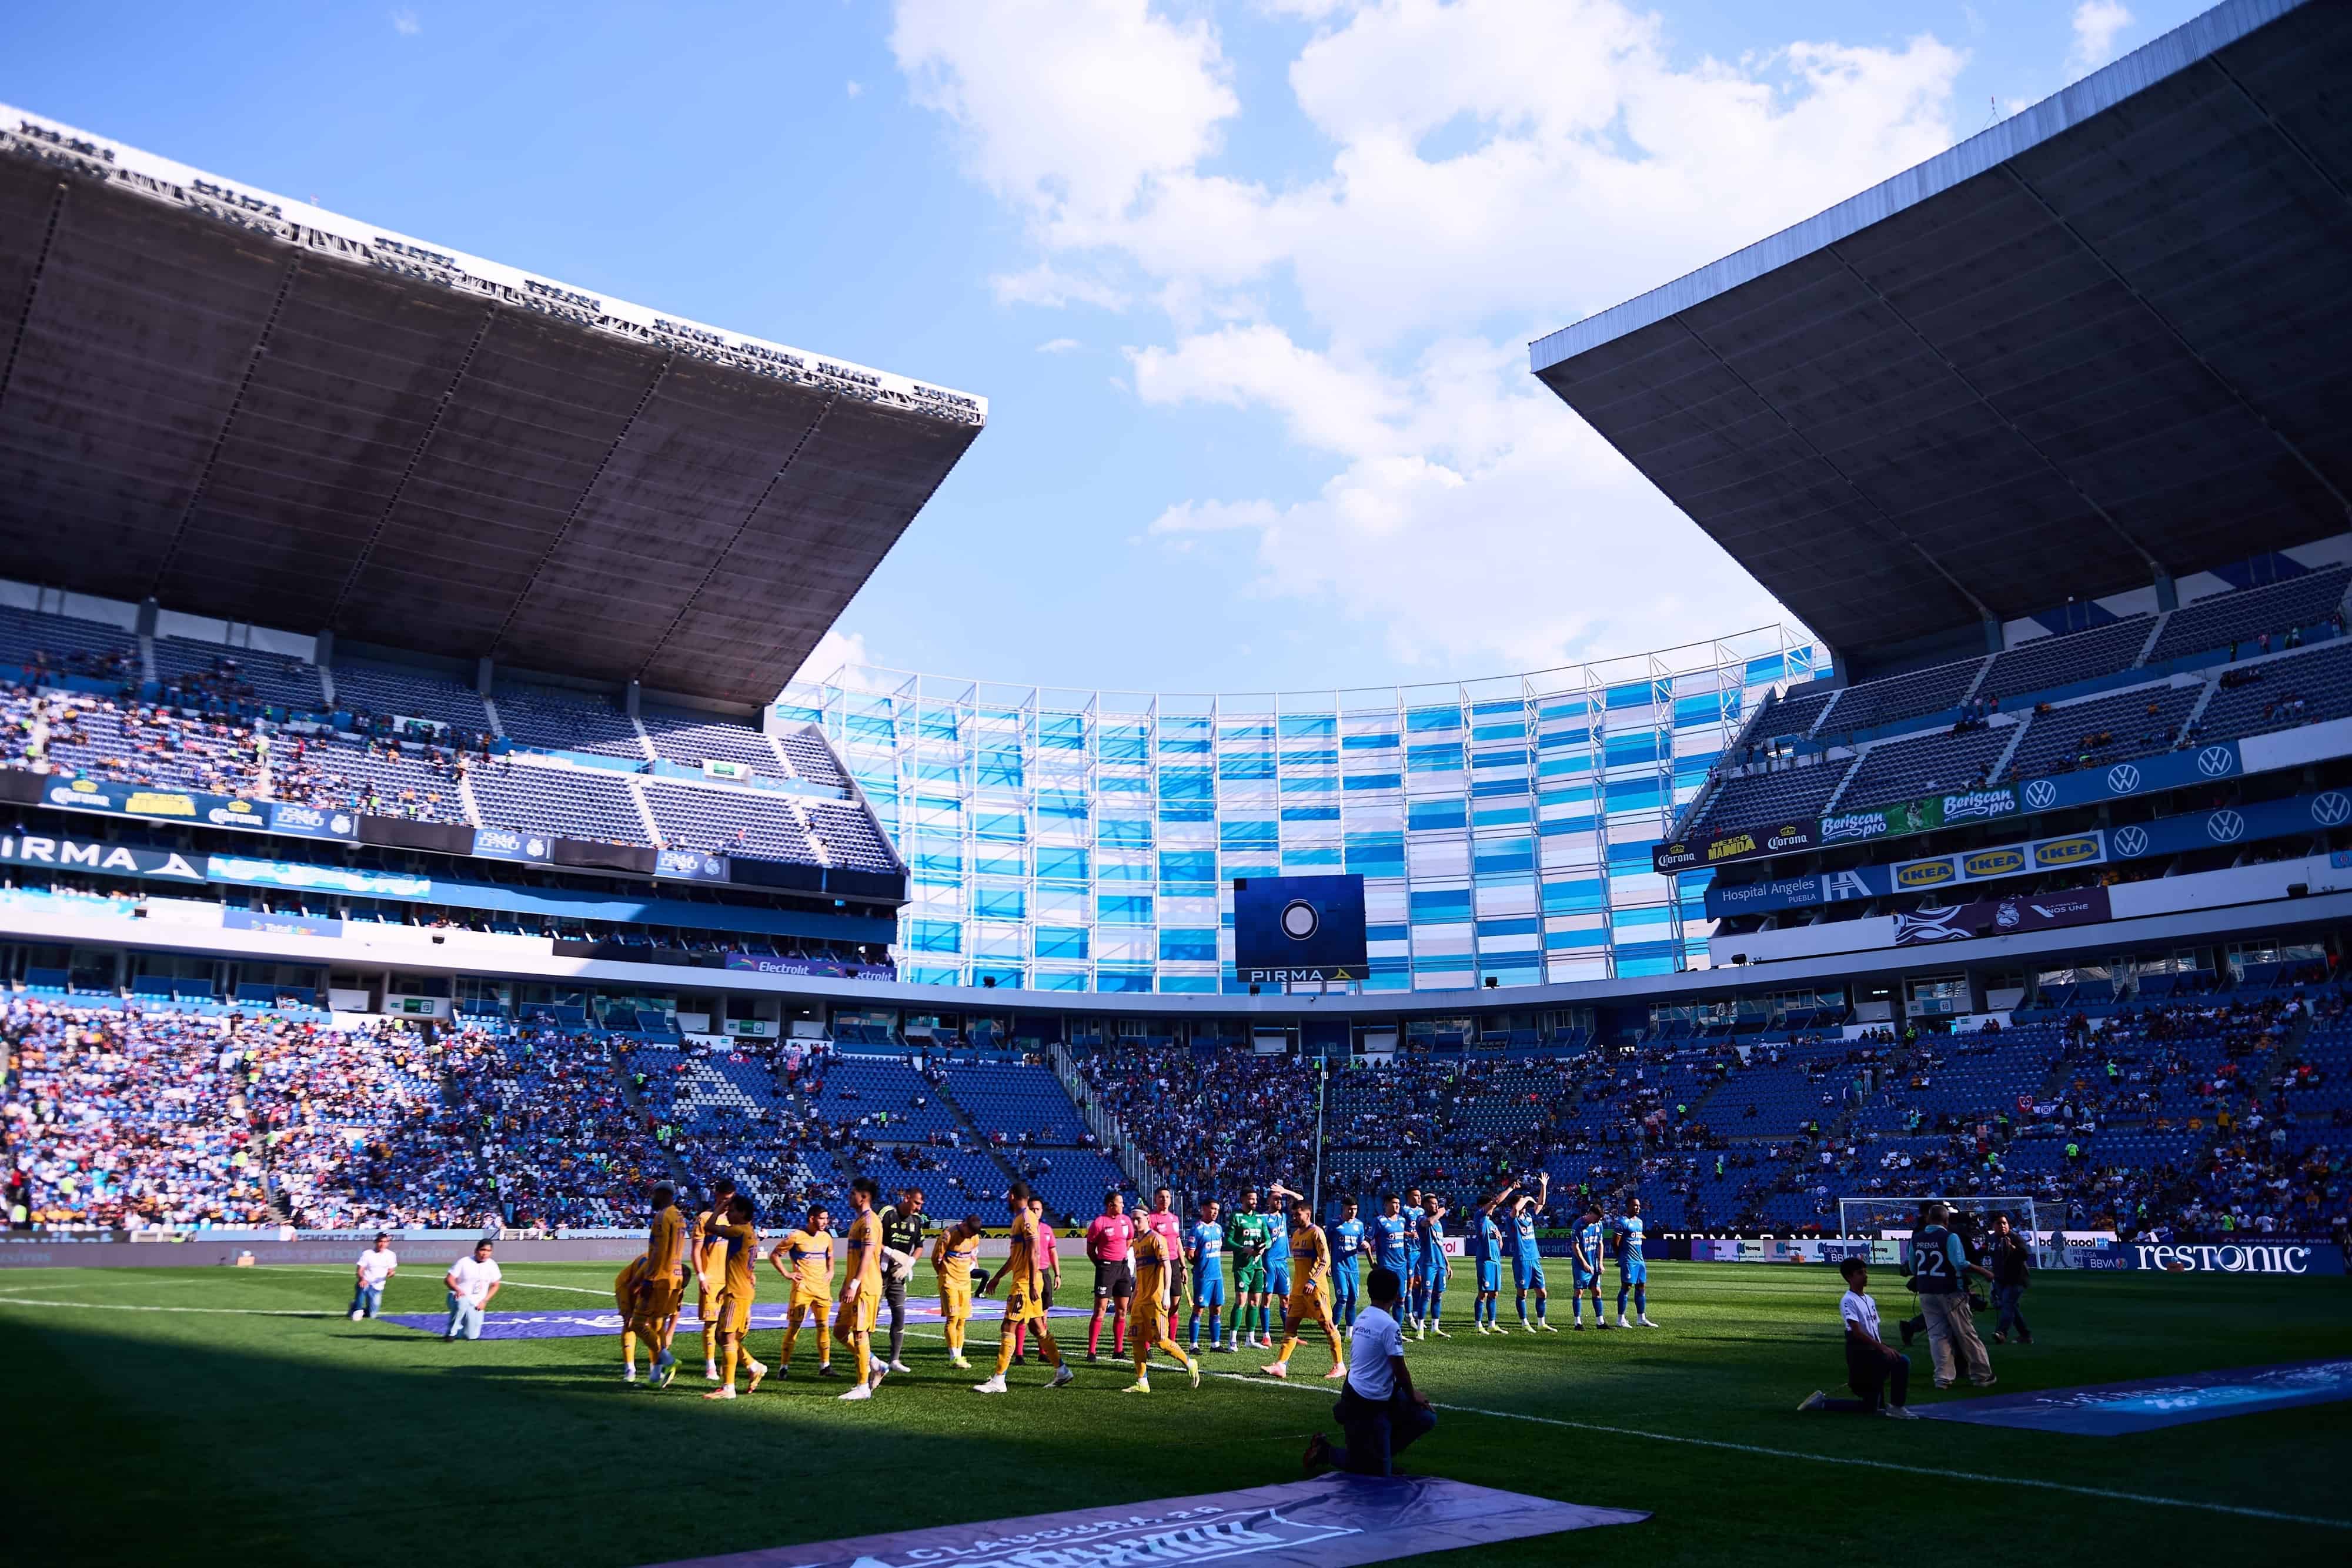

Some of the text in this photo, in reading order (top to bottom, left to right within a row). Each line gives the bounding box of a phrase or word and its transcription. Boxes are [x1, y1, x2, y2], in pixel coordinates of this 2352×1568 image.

[1990, 799, 2015, 816] pro
[1863, 822, 1887, 837] pro
[1768, 834, 1808, 851] Corona
[0, 836, 139, 871] IRMA
[1658, 852, 1696, 867] Corona
[2040, 844, 2093, 860] IKEA
[1970, 855, 2020, 870] IKEA
[1903, 865, 1950, 881] IKEA
[1722, 879, 1815, 902] Hospital Angeles
[1788, 893, 1816, 904] PUEBLA
[759, 961, 810, 975] Electrolit
[850, 969, 894, 982] ectrolit
[1251, 969, 1324, 982] PIRMA
[2039, 1237, 2096, 1247] bakaool
[1915, 1249, 1947, 1277] 22
[2090, 1258, 2115, 1268] BBVA
